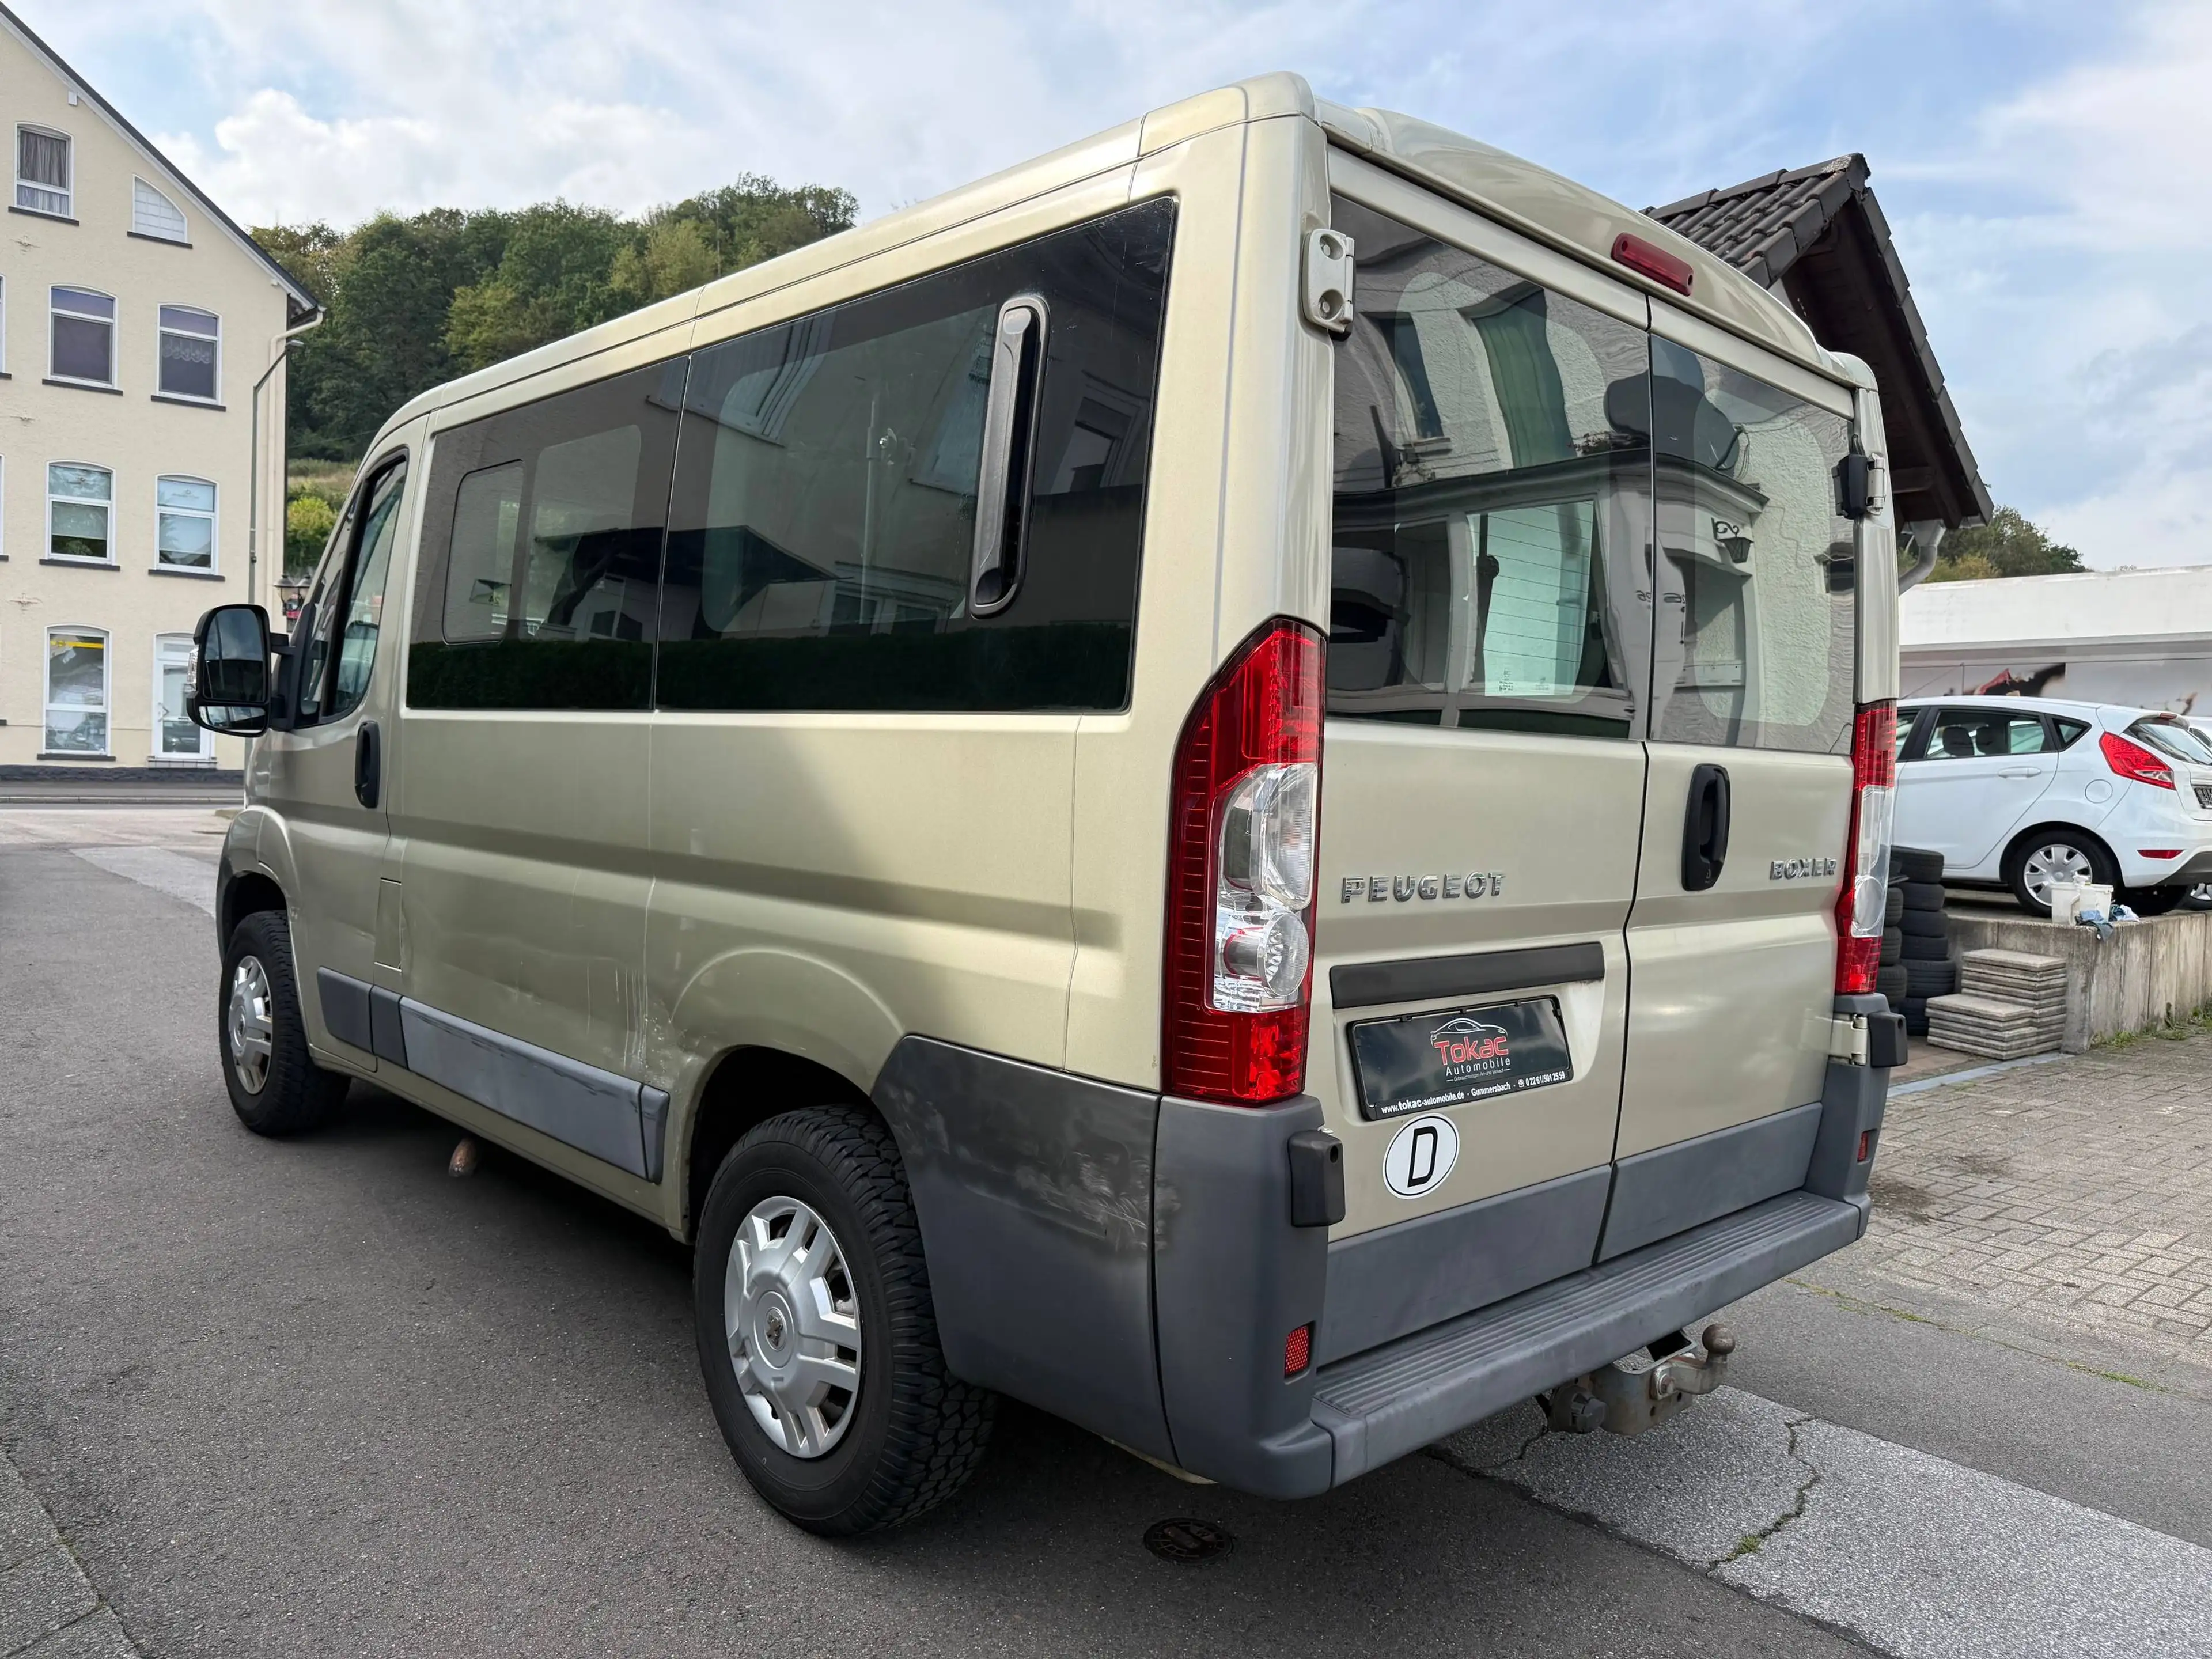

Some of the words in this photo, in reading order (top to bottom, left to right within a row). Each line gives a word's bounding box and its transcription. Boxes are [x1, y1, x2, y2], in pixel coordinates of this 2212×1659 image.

[1770, 857, 1836, 880] BOXER
[1341, 872, 1506, 903] PEUGEOT
[1434, 1036, 1509, 1066] Tokac
[1446, 1057, 1510, 1076] Automobile
[1381, 1092, 1464, 1113] www.tokac-automobile.de
[1471, 1082, 1511, 1096] Gummersbach
[1407, 1126, 1438, 1188] D
